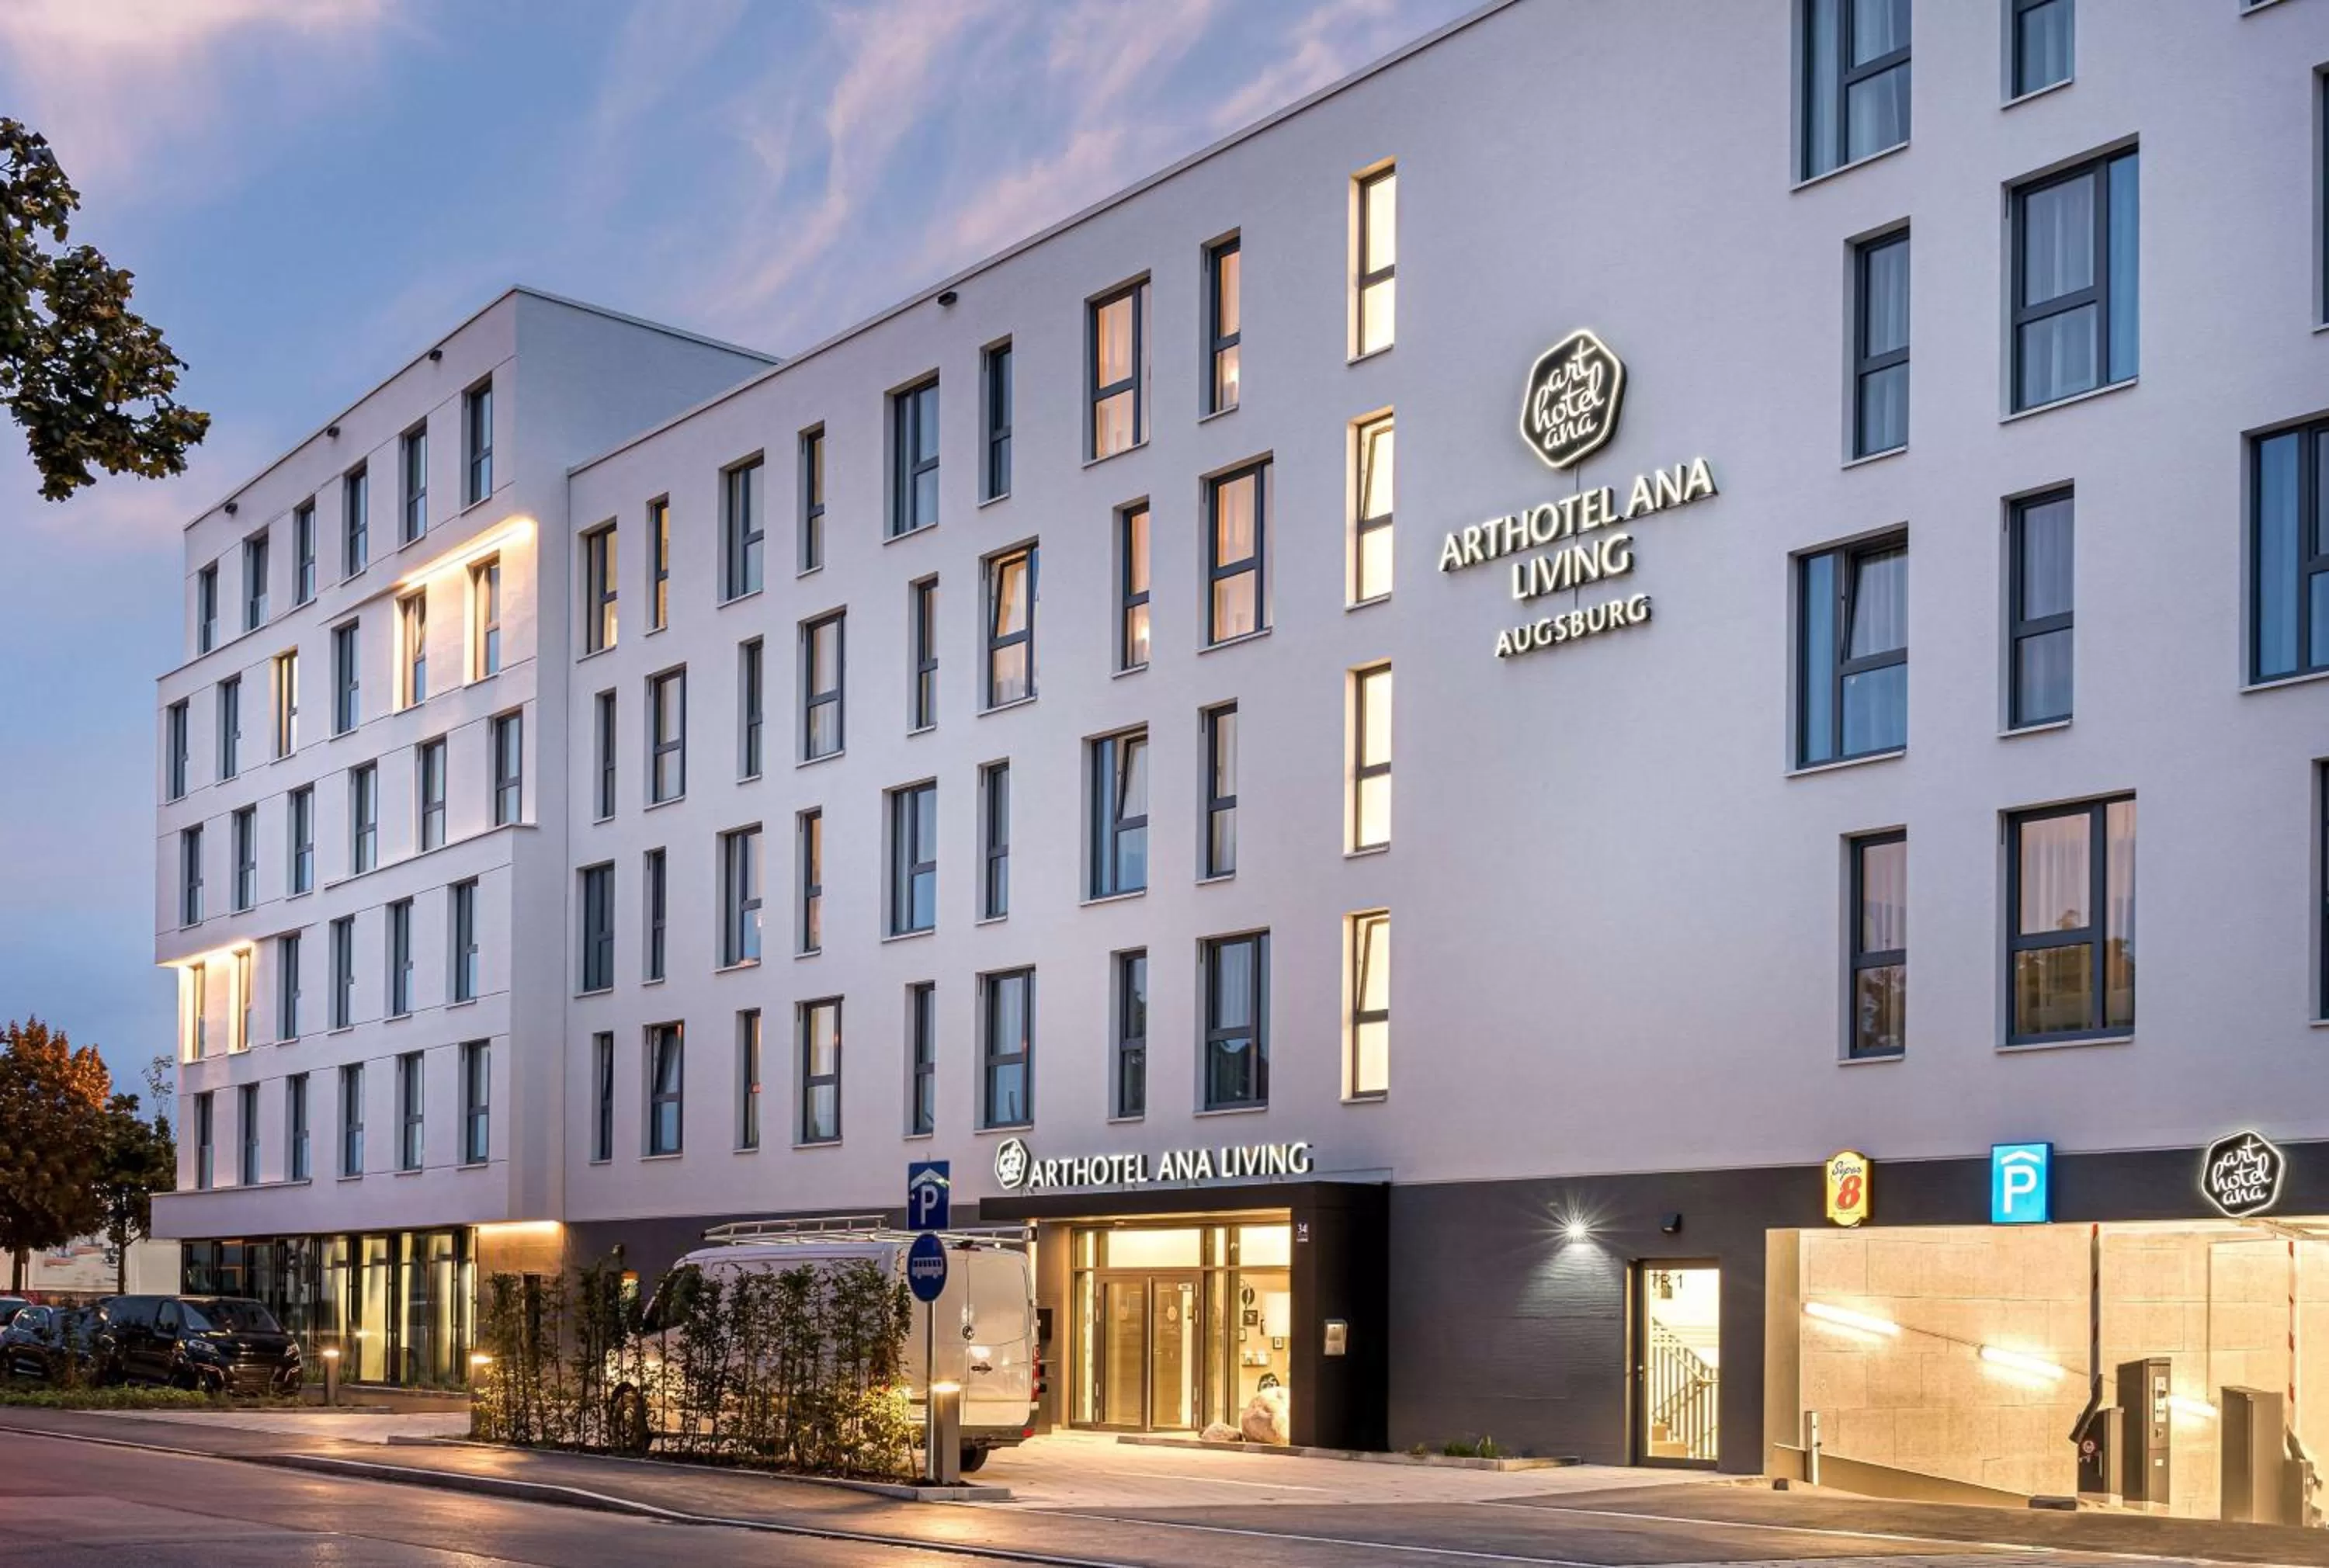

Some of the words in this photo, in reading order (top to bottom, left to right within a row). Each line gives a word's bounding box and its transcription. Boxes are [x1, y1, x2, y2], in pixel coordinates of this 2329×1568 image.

[1545, 338, 1597, 391] art
[1534, 361, 1605, 433] hotel
[1544, 412, 1598, 450] ana
[1439, 485, 1619, 572] ARTHOTEL
[1626, 456, 1718, 520] ANA
[1512, 532, 1634, 600] LIVING
[1494, 592, 1652, 658] AUGSBURG
[1029, 1153, 1148, 1188] ARTHOTEL
[1157, 1148, 1214, 1181] ANA
[1220, 1142, 1313, 1178] LIVING
[2212, 1152, 2272, 1193] hotel
[2223, 1136, 2264, 1167] art
[920, 1185, 939, 1225] P
[1835, 1174, 1862, 1210] 8
[2003, 1164, 2037, 1213] P
[2223, 1185, 2267, 1205] ana
